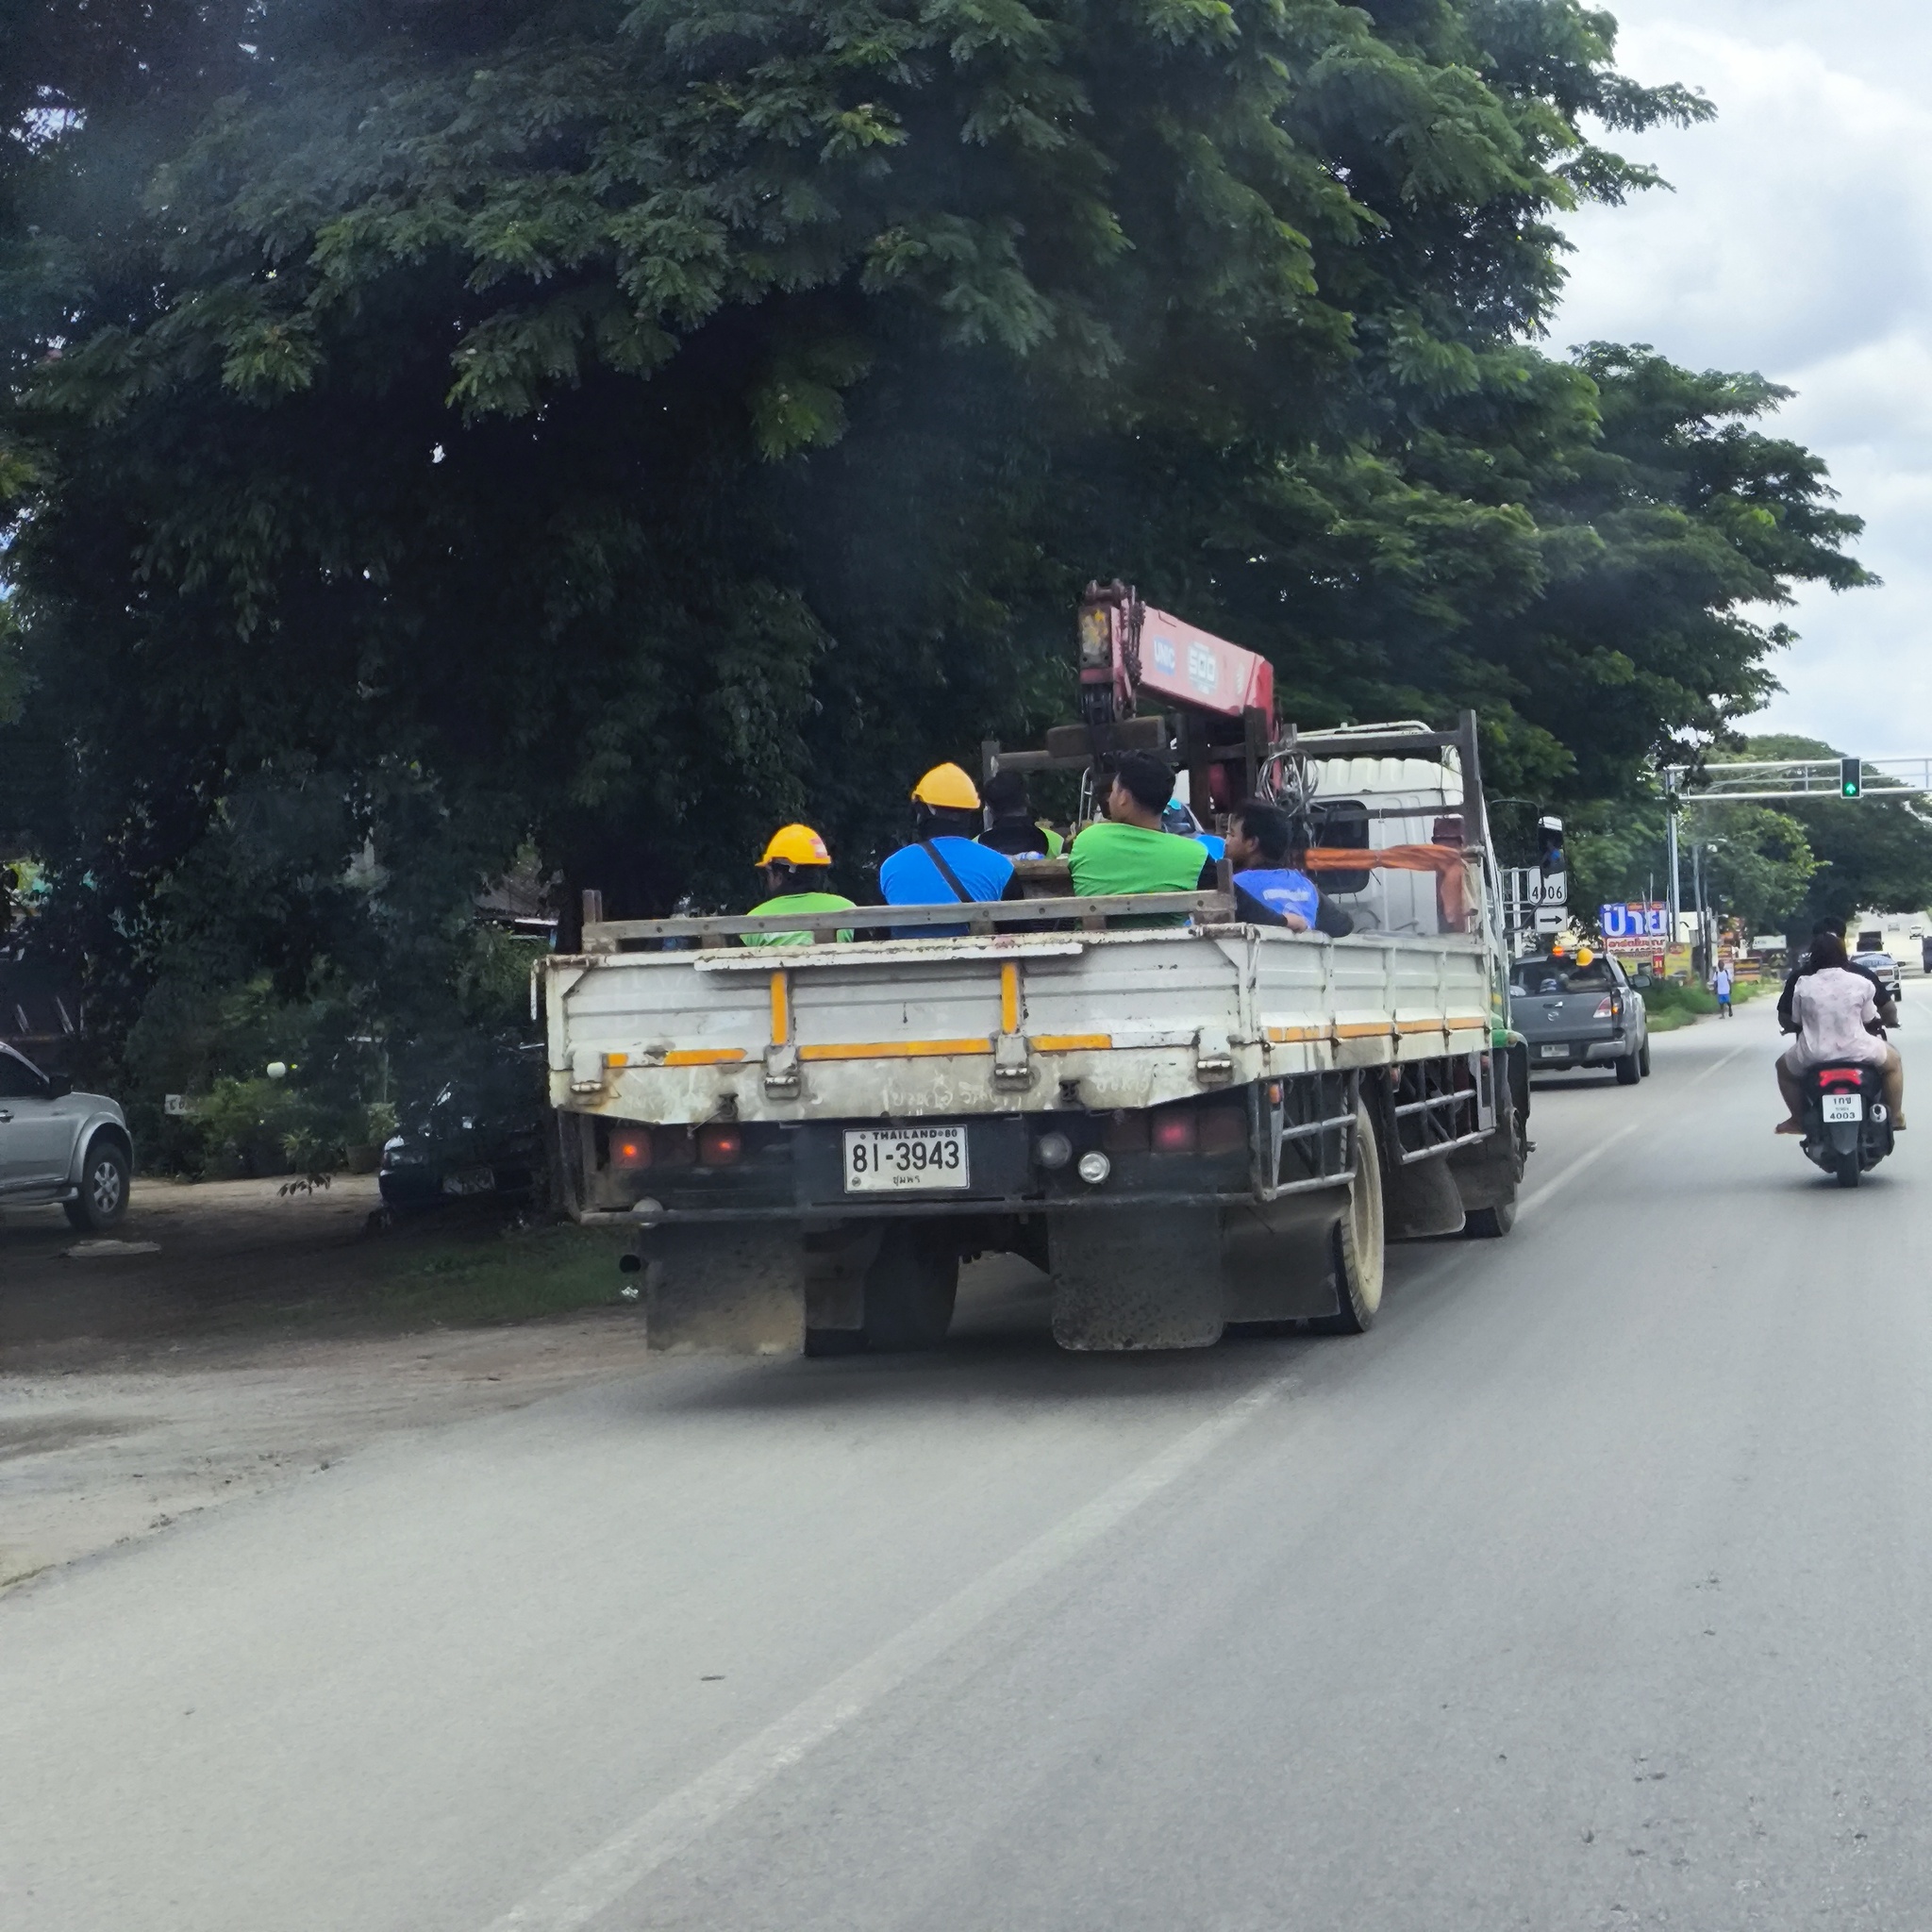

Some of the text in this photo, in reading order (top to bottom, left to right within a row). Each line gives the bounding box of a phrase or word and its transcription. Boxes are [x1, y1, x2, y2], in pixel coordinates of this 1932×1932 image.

[1532, 886, 1562, 899] 406
[873, 1130, 937, 1141] THAILAND
[853, 1141, 959, 1173] 81-3943
